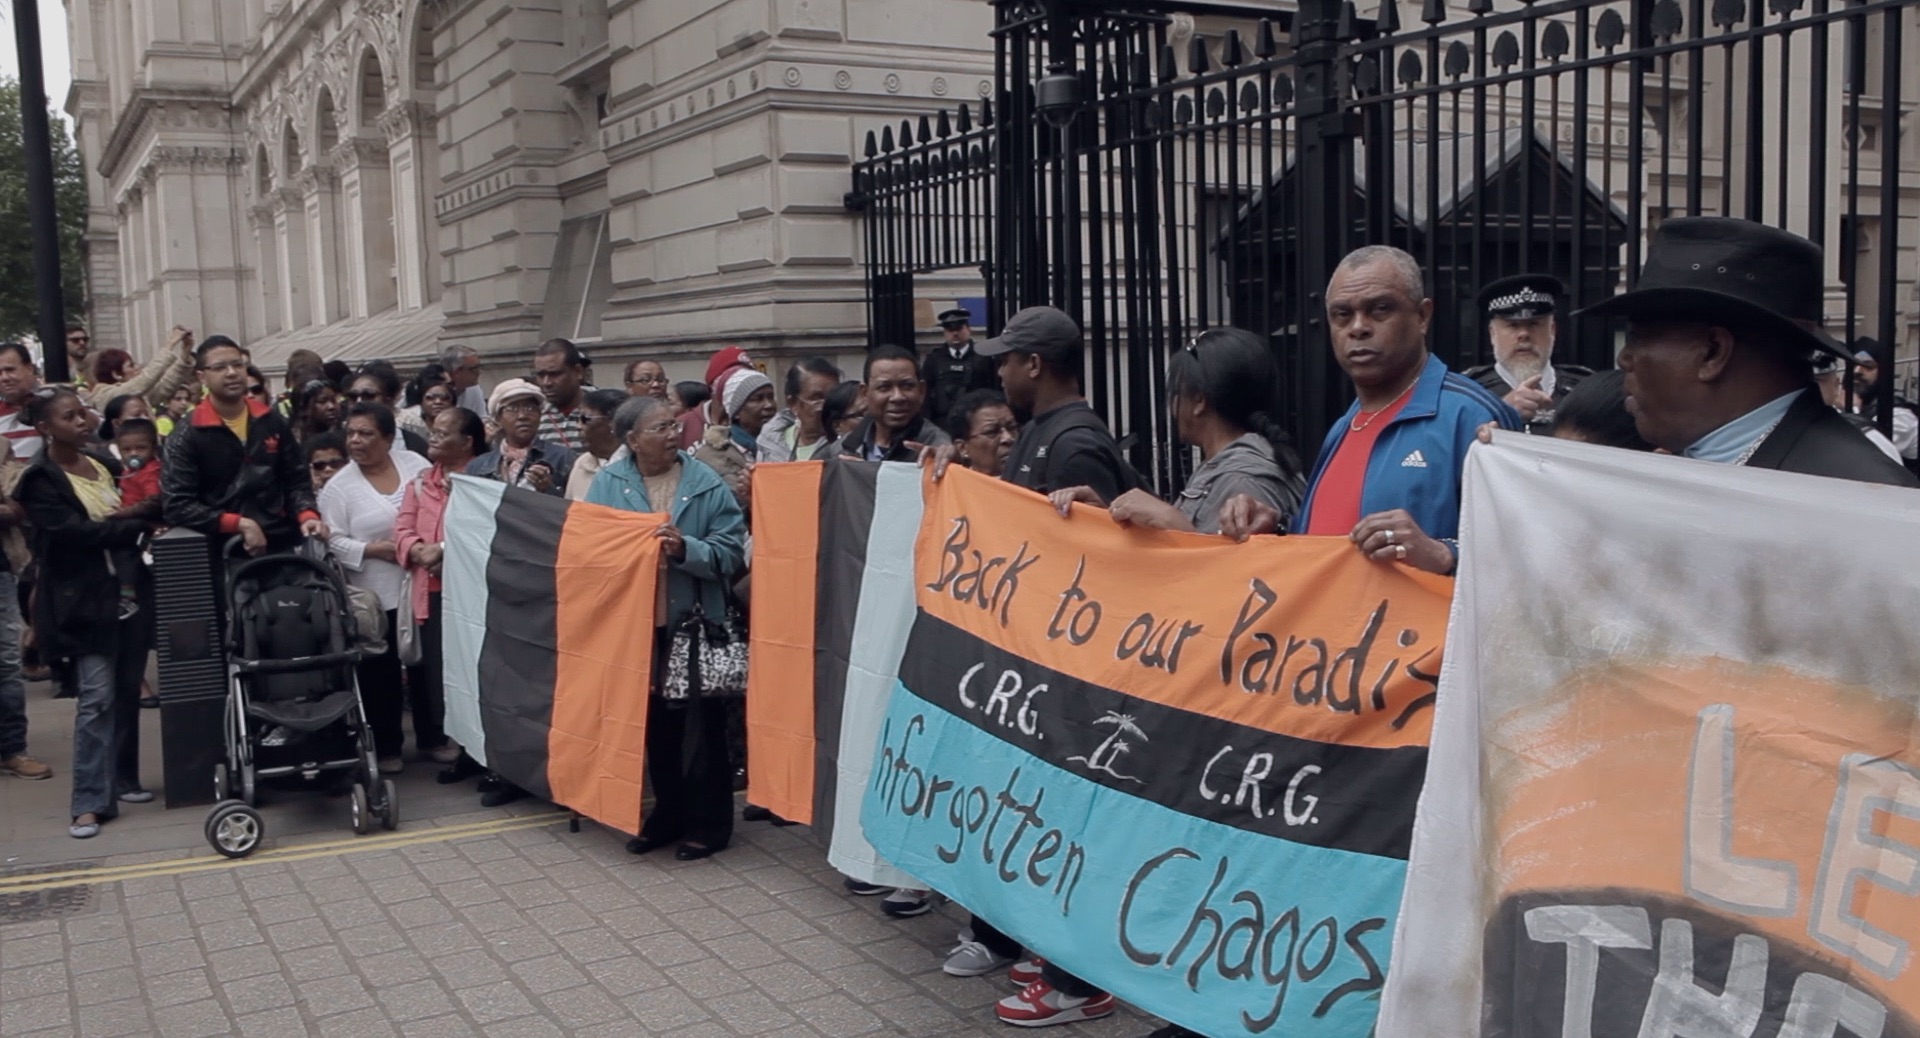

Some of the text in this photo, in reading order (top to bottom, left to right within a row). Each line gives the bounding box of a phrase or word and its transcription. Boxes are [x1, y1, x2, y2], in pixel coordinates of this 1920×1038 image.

[926, 515, 1439, 730] Back to our Paradis
[958, 661, 1049, 740] C.R.G.
[1199, 745, 1322, 826] C.R.G.
[1117, 846, 1387, 1034] Chagos
